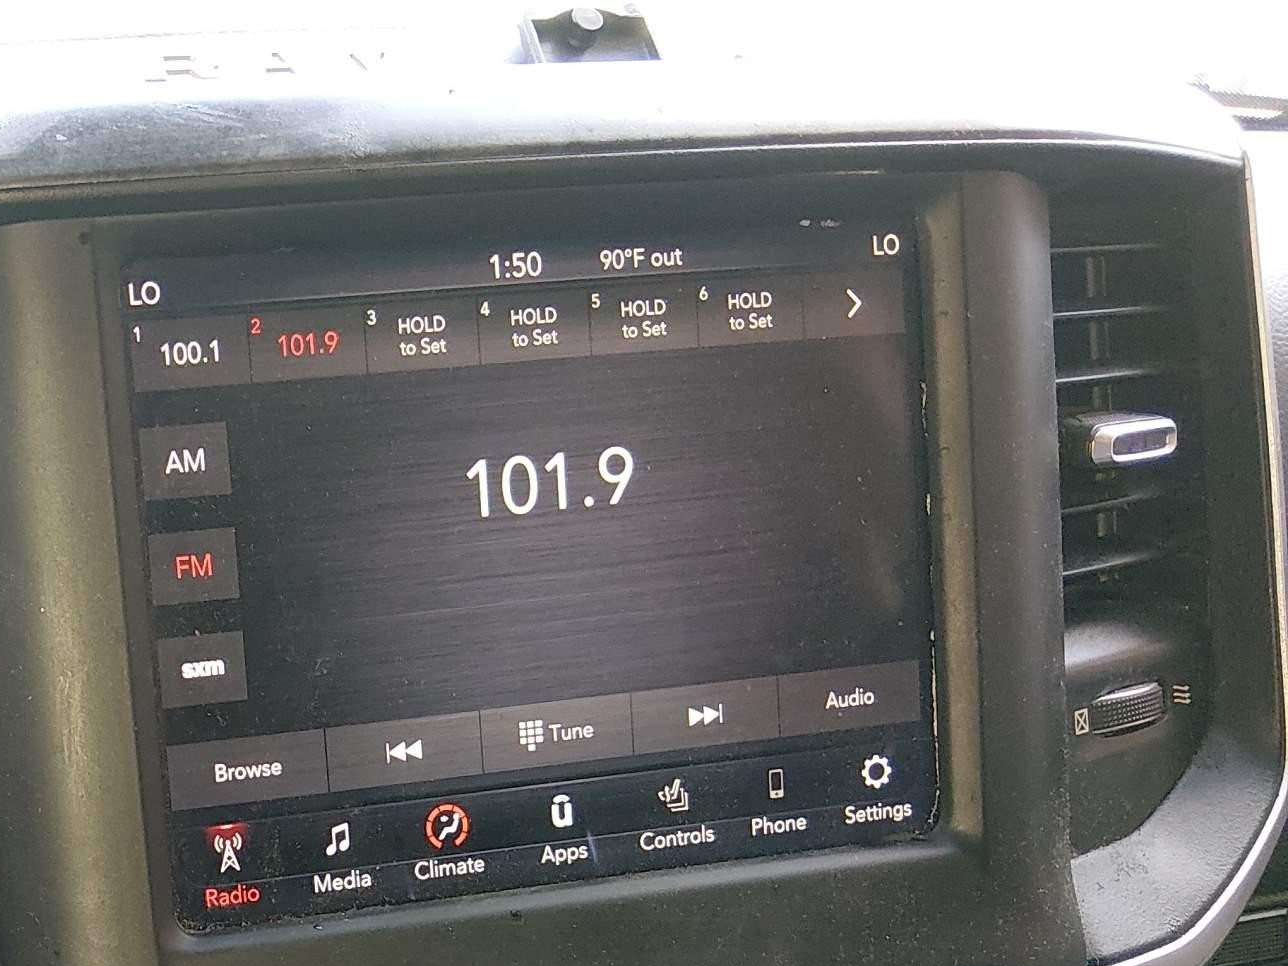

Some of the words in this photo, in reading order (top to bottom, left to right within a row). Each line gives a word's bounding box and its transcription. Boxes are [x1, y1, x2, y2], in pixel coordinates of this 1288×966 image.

[872, 234, 900, 256] LO
[488, 251, 543, 280] 1:50
[599, 247, 645, 272] 90°F
[651, 248, 683, 268] out
[127, 281, 161, 306] LO
[590, 293, 601, 309] 5
[699, 286, 709, 301] 6
[727, 291, 773, 310] HOLD
[366, 309, 377, 326] 3
[479, 301, 491, 317] 4
[510, 307, 557, 326] HOLD
[620, 299, 666, 318] HOLD
[250, 318, 262, 334] 2
[397, 315, 446, 335] HOLD
[622, 323, 638, 339] to
[642, 321, 667, 337] Set
[729, 316, 745, 331] to
[749, 314, 773, 330] Set
[132, 326, 142, 343] 1
[277, 331, 340, 358] 101.9
[512, 331, 529, 347] to
[533, 329, 558, 346] Set
[160, 339, 220, 366] 100.1
[400, 341, 416, 356] to
[421, 338, 447, 356] Set
[165, 447, 206, 474] AM
[466, 446, 634, 519] 101.9
[175, 553, 213, 579] FM
[181, 657, 225, 679] sxm
[825, 689, 875, 710] Audio
[549, 721, 594, 742] Tune
[215, 760, 283, 784] Browse
[844, 801, 913, 826] Settings
[751, 815, 807, 838] Phone
[639, 825, 715, 851] Controls
[541, 843, 588, 866] Apps
[414, 856, 485, 881] Climate
[313, 869, 372, 895] Media
[205, 885, 260, 909] Radio
